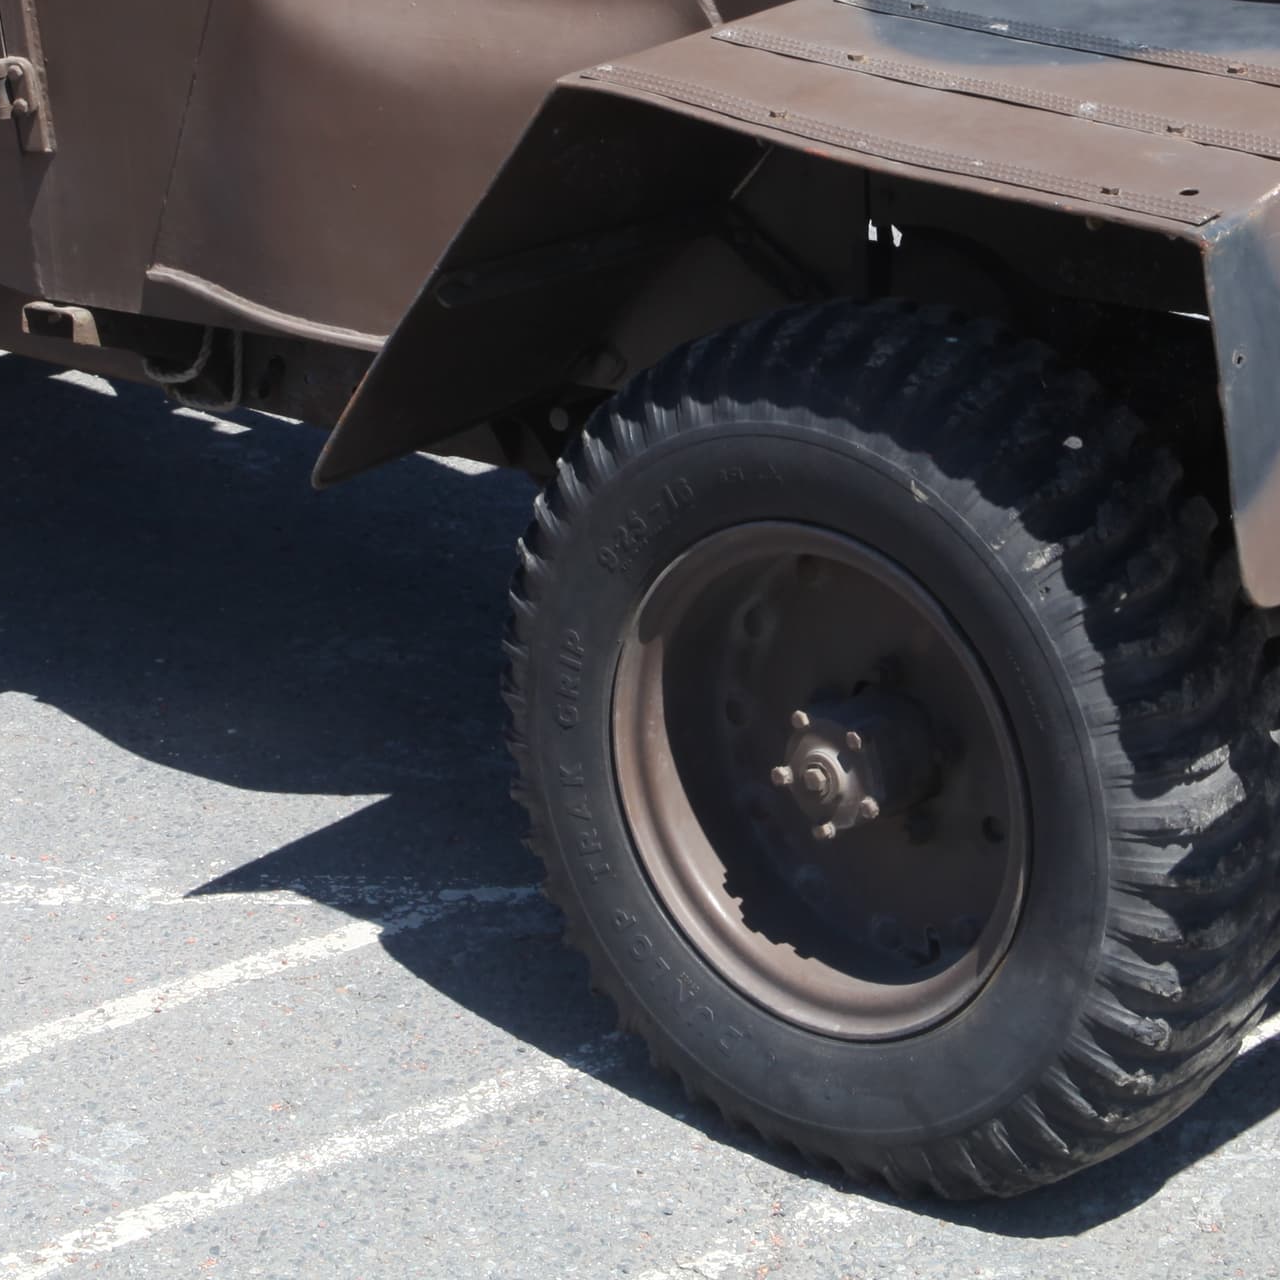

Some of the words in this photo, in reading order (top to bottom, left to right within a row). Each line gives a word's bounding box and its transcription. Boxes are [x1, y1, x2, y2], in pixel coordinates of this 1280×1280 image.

[554, 626, 586, 730] GRIP
[558, 762, 618, 885] TRAK
[613, 906, 747, 1060] DUNLOP
